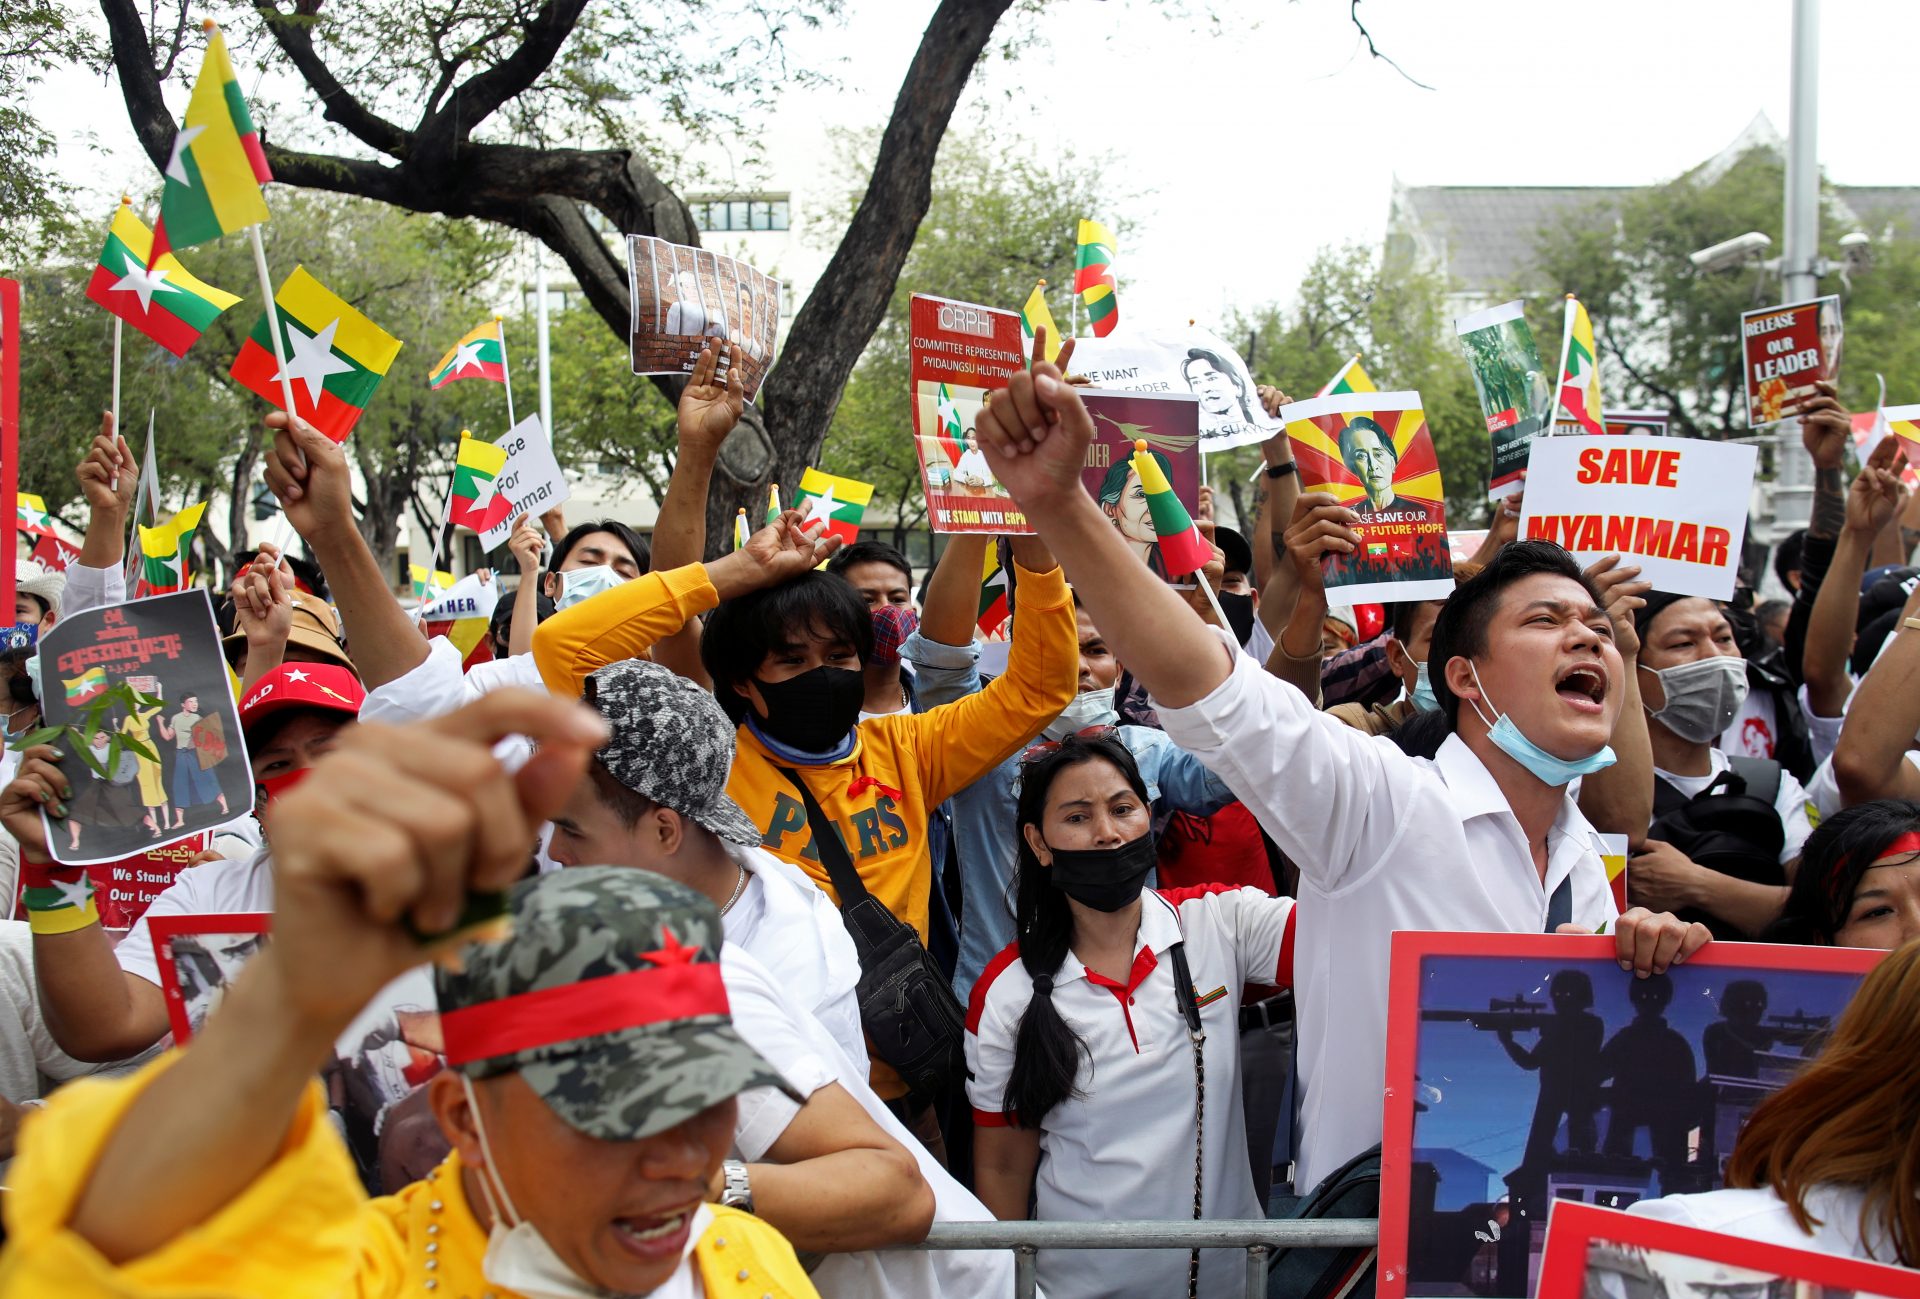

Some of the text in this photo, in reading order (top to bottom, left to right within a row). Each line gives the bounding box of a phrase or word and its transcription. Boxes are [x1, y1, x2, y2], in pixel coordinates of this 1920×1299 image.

[940, 306, 991, 335] CRPH
[1745, 312, 1796, 337] RELEASE
[913, 337, 1020, 363] COMMITTEE REPRESENTING
[1766, 337, 1794, 355] OUR
[923, 356, 1013, 378] PYIDAUNGSU HLUTTAW
[1102, 367, 1139, 381] WANT
[1754, 349, 1819, 382] LEADER
[1576, 448, 1681, 488] SAVE
[497, 470, 519, 494] For
[937, 509, 1027, 525] WE STAND WITH CRPH
[1376, 512, 1404, 523] SAVE
[1405, 511, 1427, 521] OUR
[1370, 524, 1412, 536] FUTURE
[1417, 523, 1444, 533] HOPE
[1526, 515, 1731, 567] MYANMAR
[243, 684, 274, 710] NLD
[113, 868, 132, 881] We
[137, 870, 171, 884] Stand
[110, 888, 134, 902] Our
